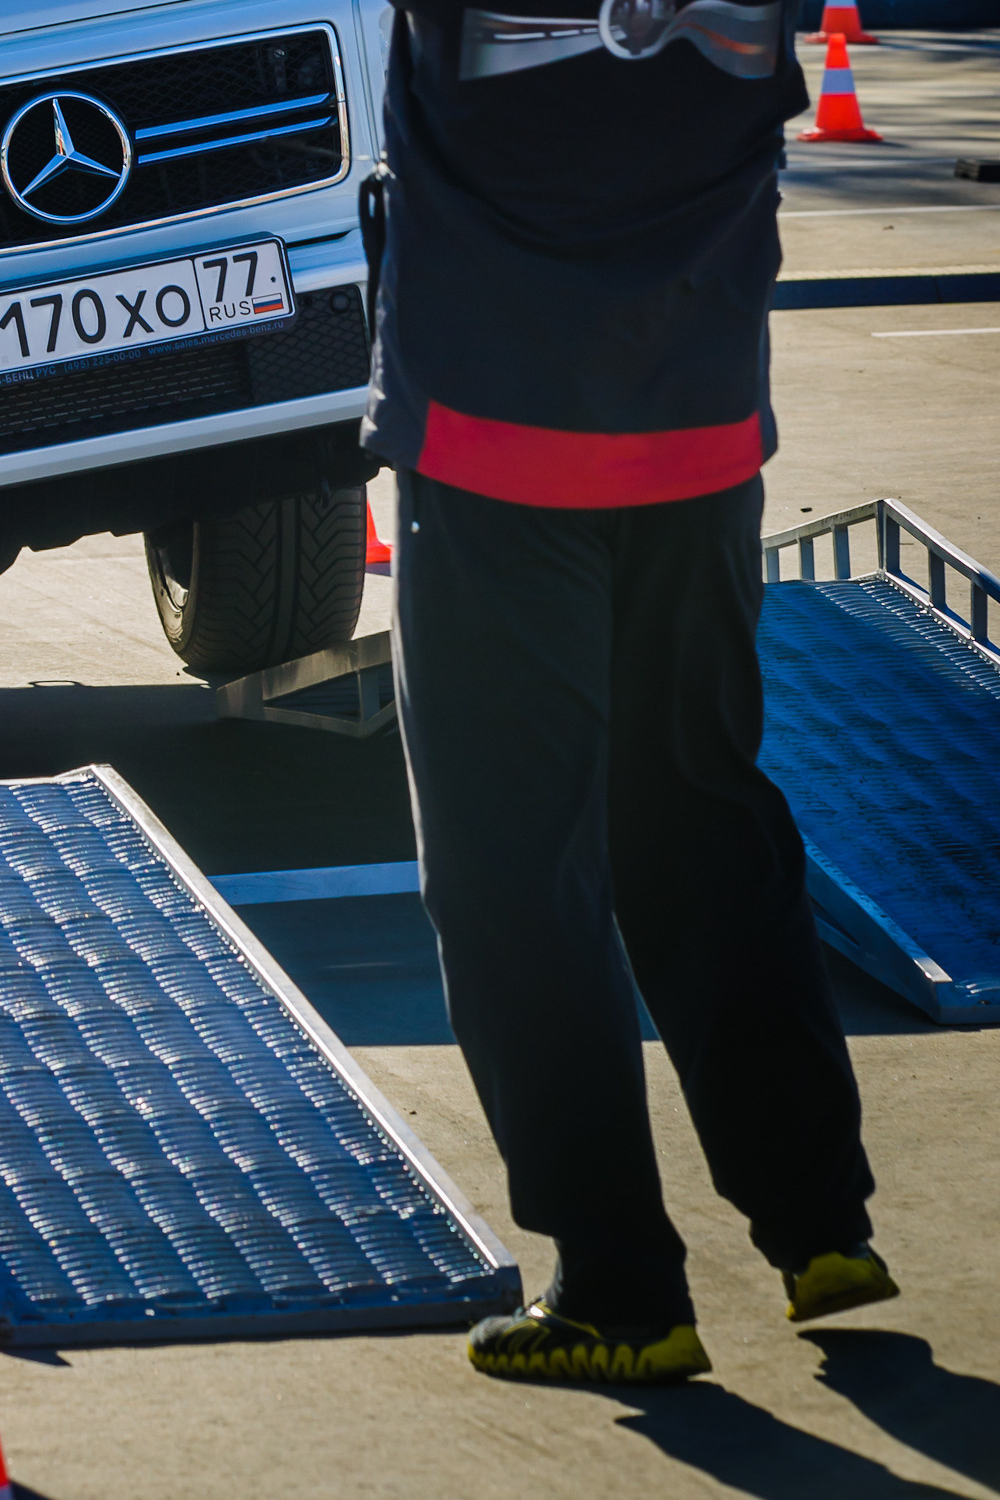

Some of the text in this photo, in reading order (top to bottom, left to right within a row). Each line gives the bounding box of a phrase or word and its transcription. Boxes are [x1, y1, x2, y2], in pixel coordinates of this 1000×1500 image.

[202, 251, 259, 303] 77
[209, 300, 251, 323] RUS
[64, 359, 90, 373] (495)
[148, 320, 284, 356] www.sales.mercedes-benz.ru
